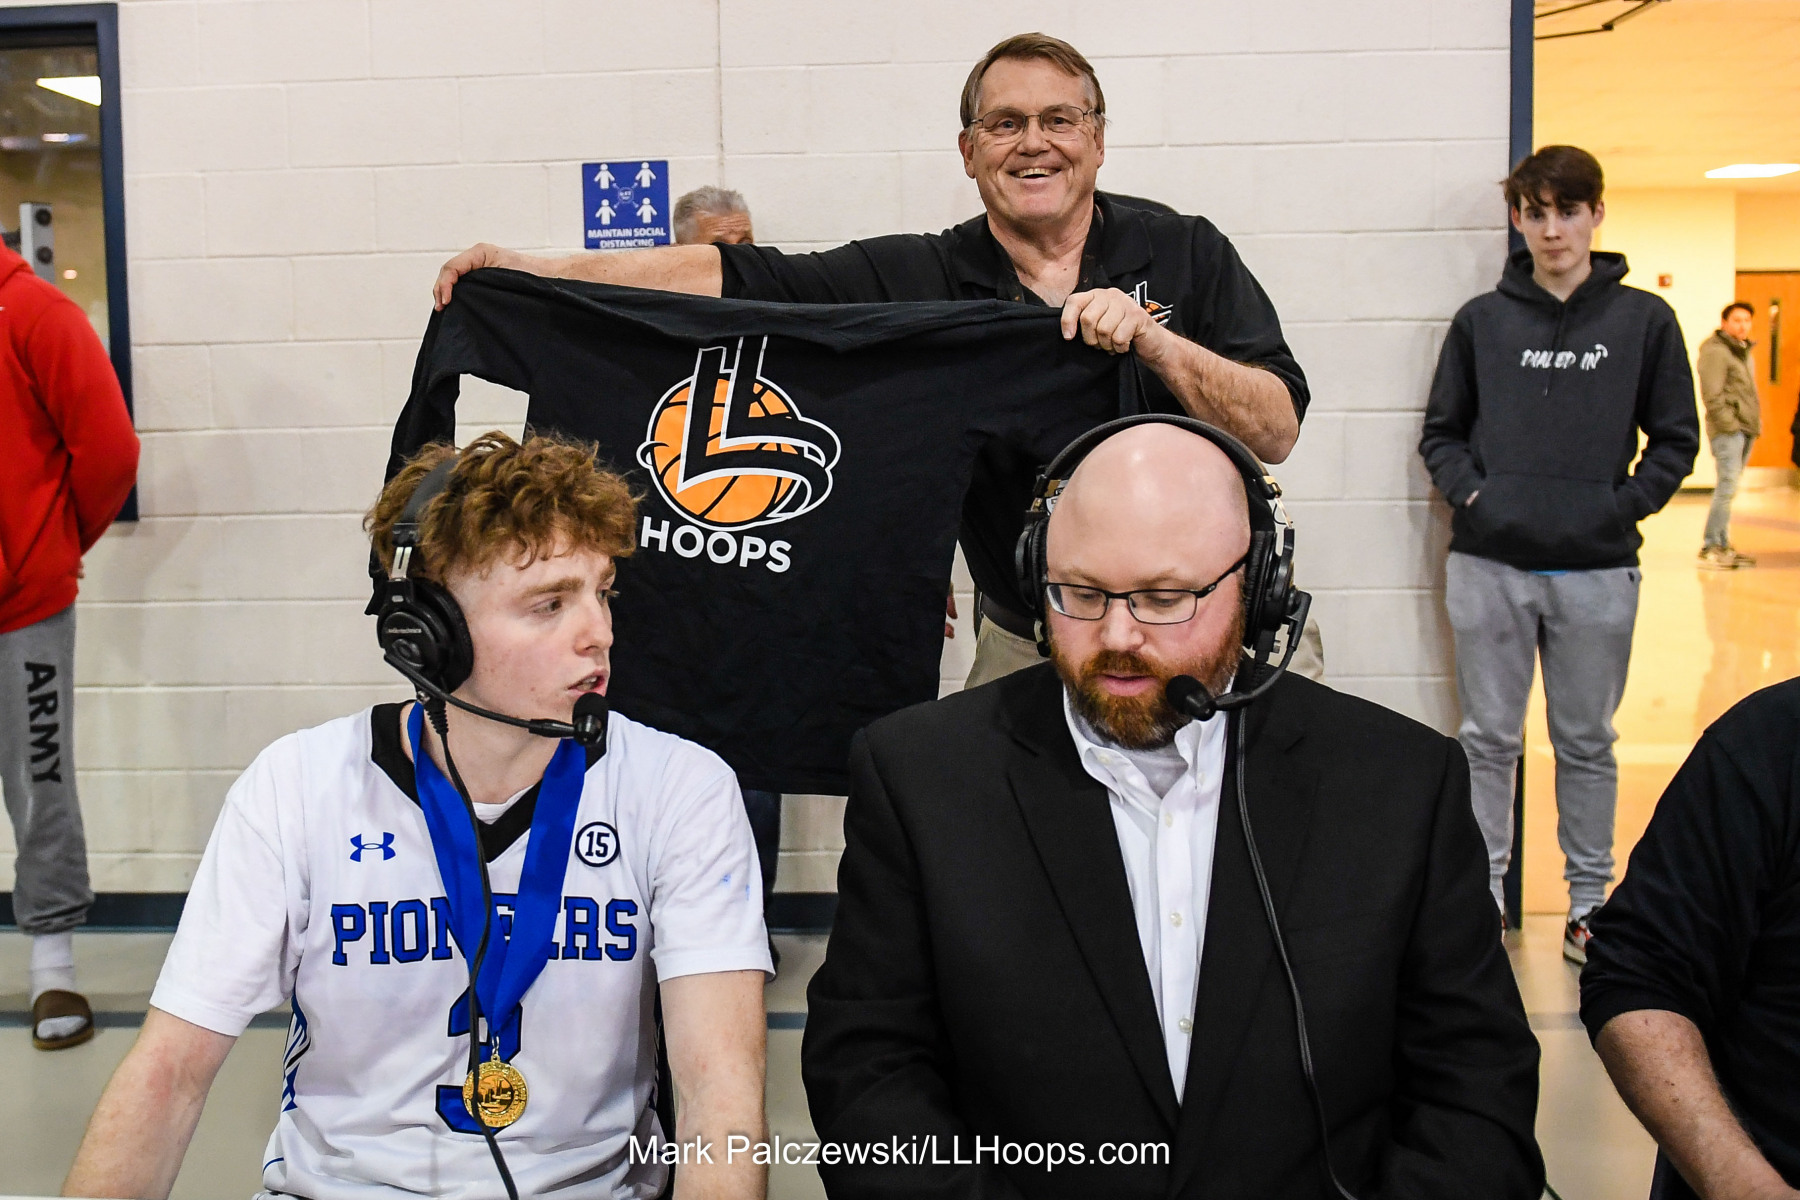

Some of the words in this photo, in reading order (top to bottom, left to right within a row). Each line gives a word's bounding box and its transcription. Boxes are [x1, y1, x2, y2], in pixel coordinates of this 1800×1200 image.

[587, 228, 632, 239] MAINTAIN
[633, 227, 667, 237] SOCIAL
[599, 238, 655, 249] DISTANCING
[640, 515, 792, 573] HOOPS
[24, 661, 62, 784] ARMY
[585, 831, 610, 858] 15
